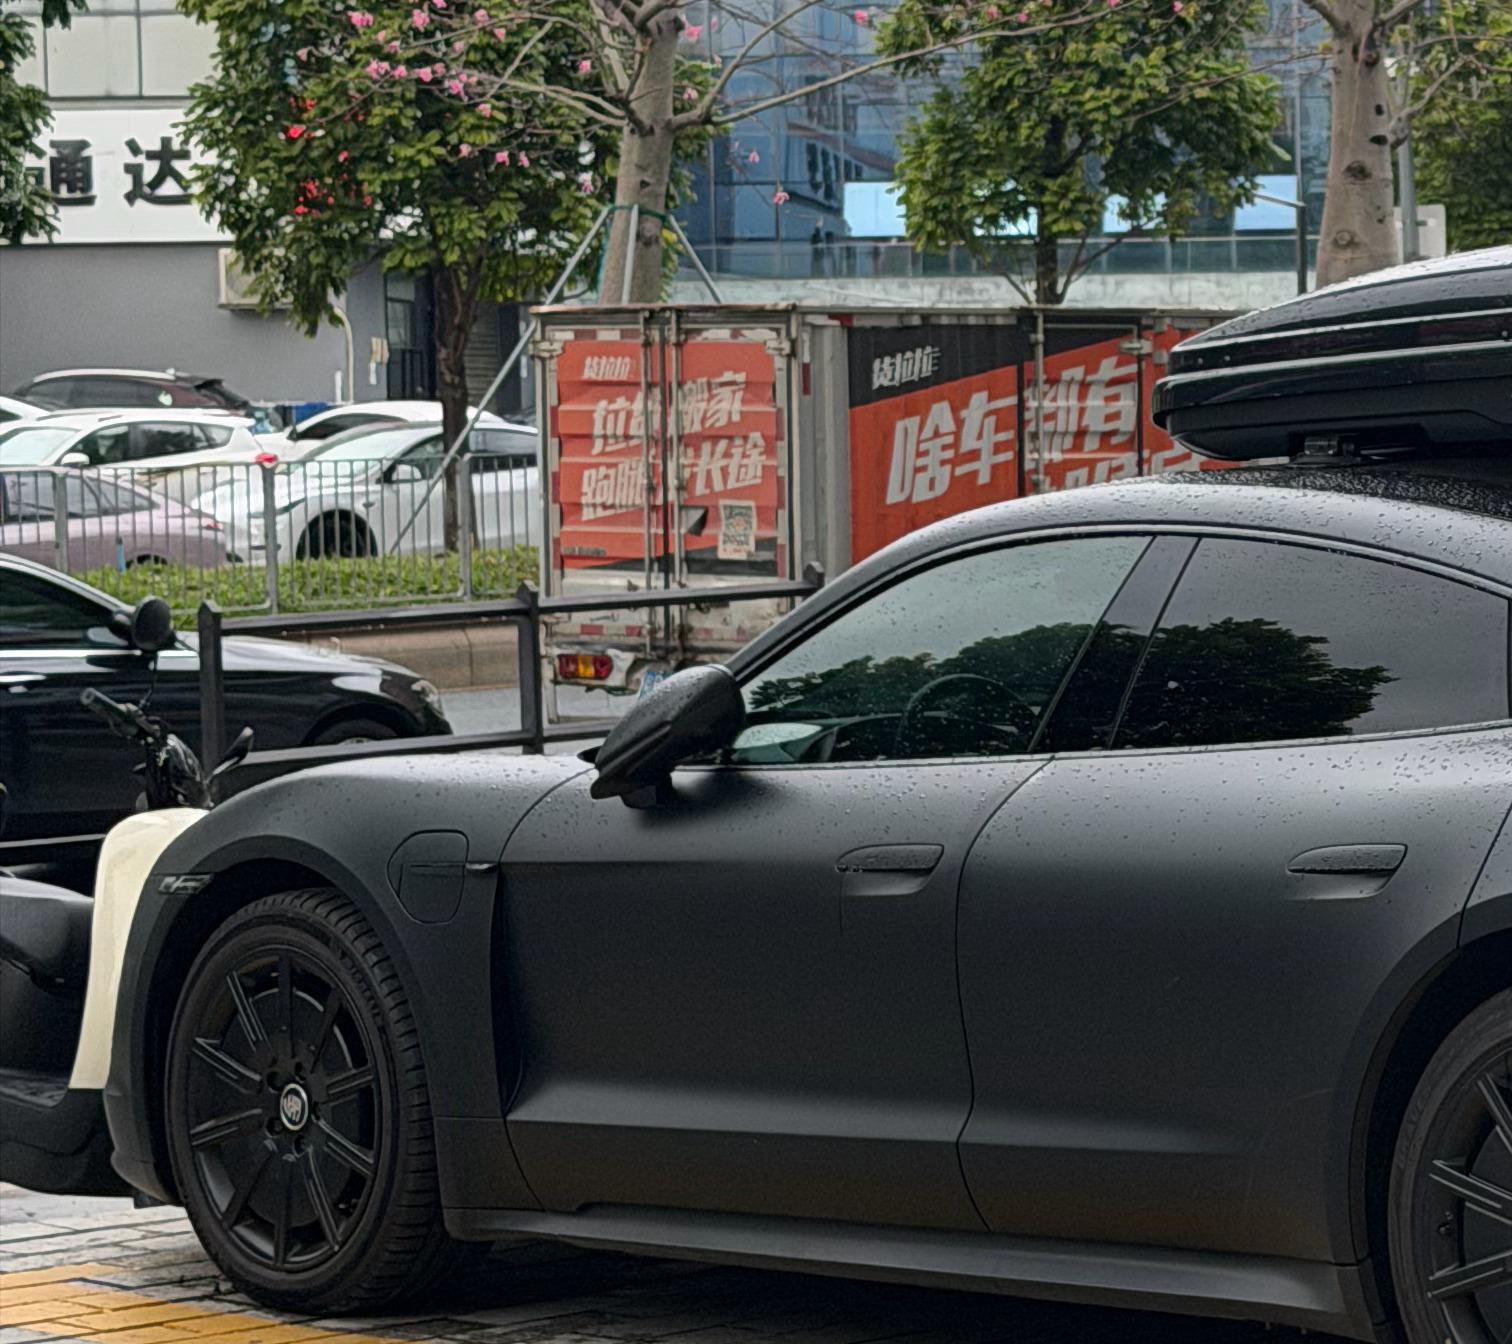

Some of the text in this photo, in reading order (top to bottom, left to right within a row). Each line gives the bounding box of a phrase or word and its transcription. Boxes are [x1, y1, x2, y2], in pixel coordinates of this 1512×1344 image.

[25, 136, 192, 208] 通达
[872, 345, 942, 391] 货拉拉
[886, 355, 1137, 506] 啥车都有
